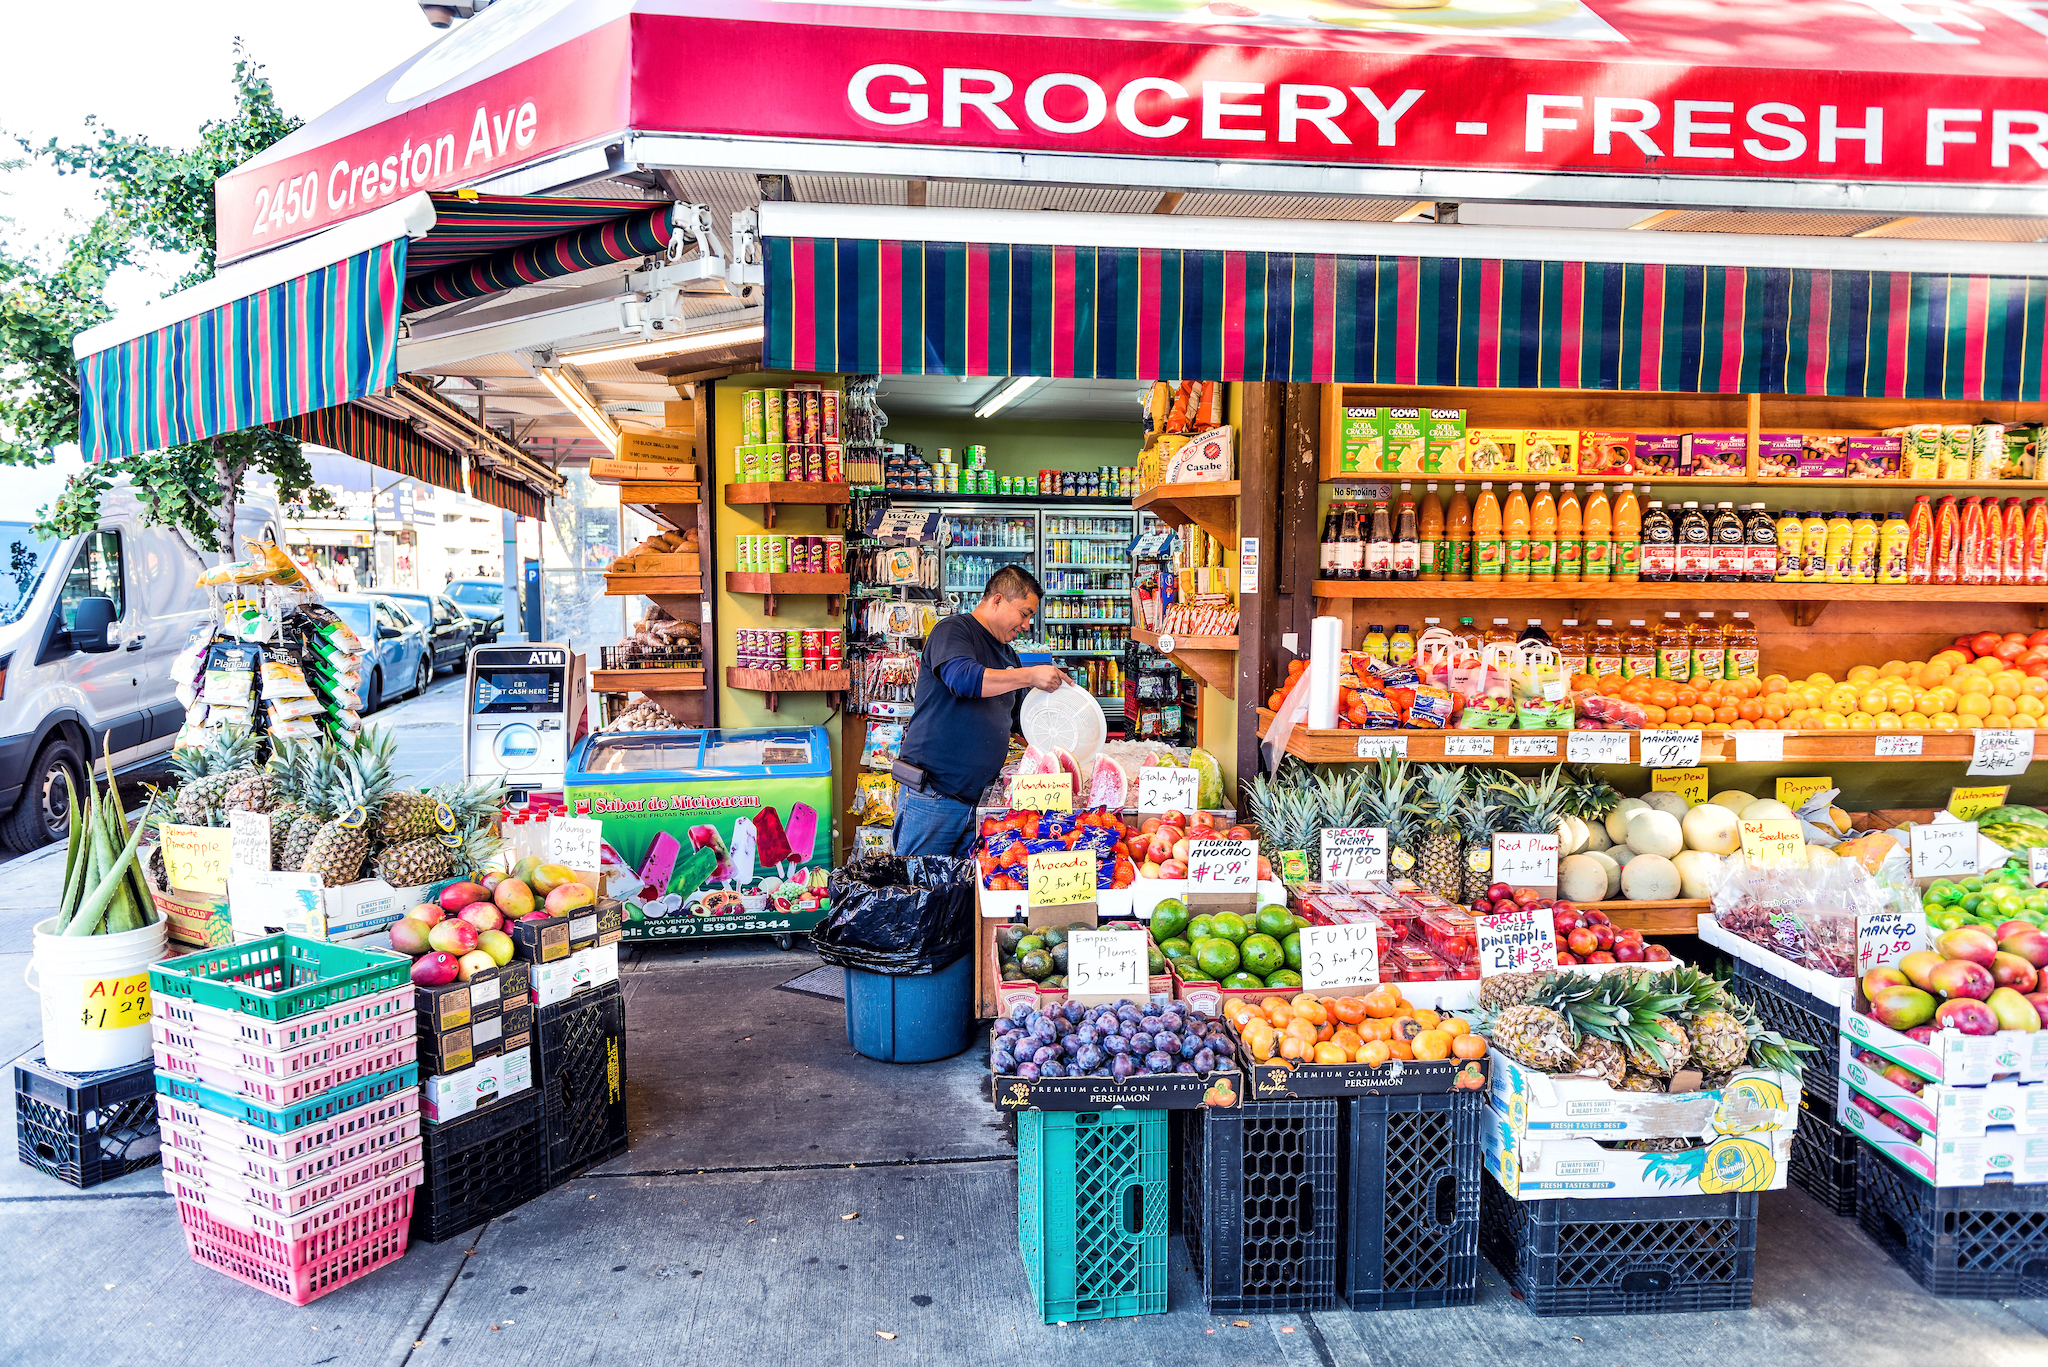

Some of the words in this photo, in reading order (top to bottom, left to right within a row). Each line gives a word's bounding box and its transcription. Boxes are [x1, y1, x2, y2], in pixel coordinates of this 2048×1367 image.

[847, 63, 1424, 147] GROCERY
[1525, 94, 1883, 164] FRESH
[252, 176, 318, 235] 2450
[326, 134, 456, 207] Creston
[463, 101, 537, 168] Ave
[1348, 408, 1376, 418] GOYA
[1390, 408, 1418, 418] GOYA
[1432, 410, 1459, 418] GOYA
[1194, 430, 1220, 444] Casabe
[1730, 436, 1745, 444] SWEET
[1186, 462, 1222, 472] Casabe
[1334, 488, 1344, 496] No
[1346, 488, 1377, 498] Smoking
[528, 571, 536, 581] P
[214, 659, 250, 668] Plantain
[262, 652, 298, 664] Plantain
[528, 652, 562, 664] ATM
[1571, 733, 1595, 743] Gala
[1600, 734, 1627, 744] Apple
[1642, 735, 1700, 743] MANDARINE
[1878, 736, 1909, 744] Florida
[1982, 738, 2020, 746] ORANGE
[1141, 771, 1167, 782] Gala
[1170, 771, 1196, 786] Apple
[1014, 781, 1070, 791] Mandarines
[1784, 782, 1827, 794] Papaya
[1684, 787, 1699, 797] 99
[595, 798, 644, 813] Sabor
[647, 796, 667, 811] de
[670, 794, 761, 810] Michoacan
[1144, 790, 1157, 806] 2
[556, 822, 592, 840] Mango
[1744, 822, 1763, 834] Red
[1759, 831, 1800, 842] Seedless
[1924, 829, 1964, 840] Limes
[554, 838, 562, 856] 3
[1198, 840, 1242, 848] FLORIDA
[1334, 837, 1374, 846] CHERRY
[1498, 840, 1521, 850] Red
[1192, 848, 1251, 858] AVOCADO
[1326, 847, 1380, 857] TOMATO
[1032, 857, 1088, 873] Avocado
[1501, 858, 1514, 876] 4
[1037, 876, 1050, 896] 2
[1054, 877, 1071, 890] for
[167, 902, 186, 915] MONTE
[187, 908, 206, 919] GOLD
[1870, 914, 1901, 924] FRESH
[345, 922, 364, 930] FRESH
[621, 926, 642, 936] el:
[648, 924, 696, 936] (347)
[702, 920, 790, 931] 590-5344
[1496, 921, 1534, 932] SWEET
[1860, 923, 1916, 939] MANGO
[1075, 934, 1118, 947] Empress
[1310, 928, 1367, 945] FUYU
[1098, 946, 1137, 959] Plums
[1495, 948, 1509, 968] 2
[1309, 952, 1324, 976] 3
[1332, 952, 1349, 966] for
[1077, 962, 1090, 986] 5
[1097, 966, 1117, 978] for
[89, 980, 147, 998] Aloe
[1348, 1069, 1421, 1077] CALIFONIA
[1426, 1067, 1459, 1075] FRUIT
[1031, 1085, 1086, 1093] PREMIUM
[1092, 1084, 1168, 1092] CALIFORNIA
[1173, 1083, 1208, 1091] FRUIT
[1345, 1078, 1403, 1087] PERSIMMON
[1090, 1094, 1150, 1103] PERSIMMON
[1718, 1162, 1745, 1175] Chiquita
